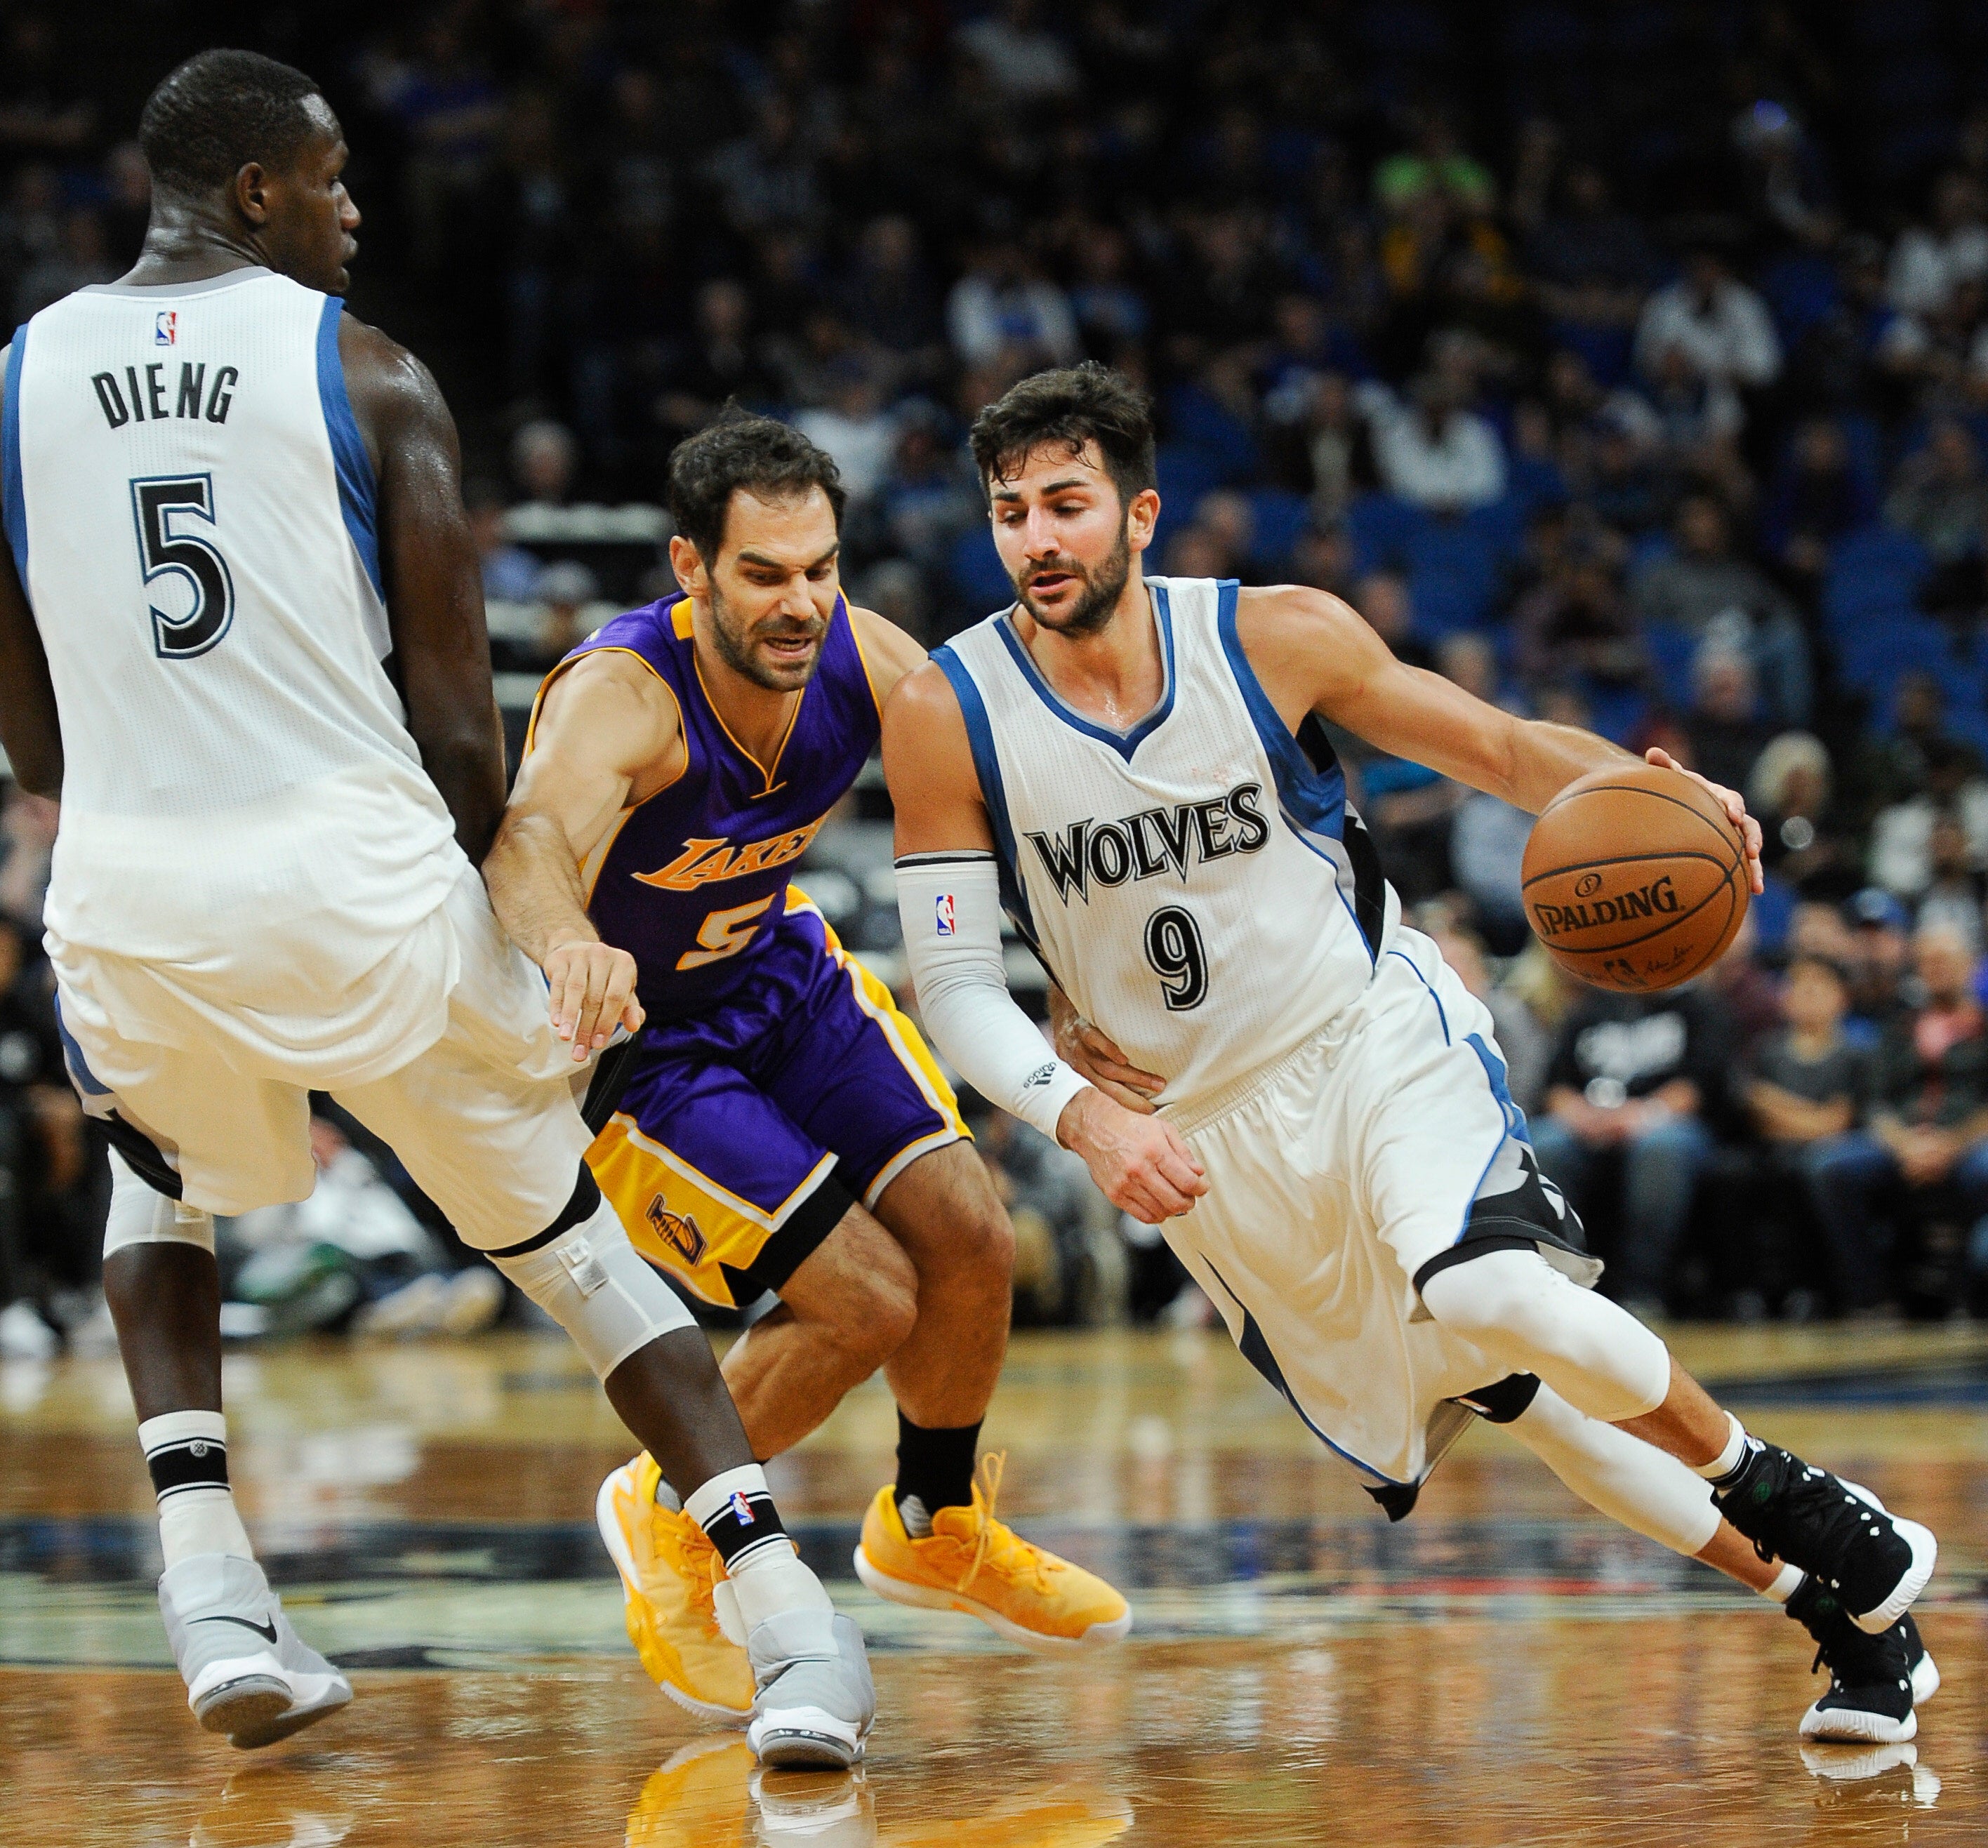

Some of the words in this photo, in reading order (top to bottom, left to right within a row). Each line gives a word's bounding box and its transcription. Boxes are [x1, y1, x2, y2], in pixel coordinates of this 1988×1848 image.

[91, 361, 239, 429] DIENG
[128, 472, 235, 660] 5
[630, 809, 830, 891] LAKE
[1022, 783, 1271, 908] WOLVES
[675, 892, 777, 971] 5
[1144, 905, 1209, 1011] 9
